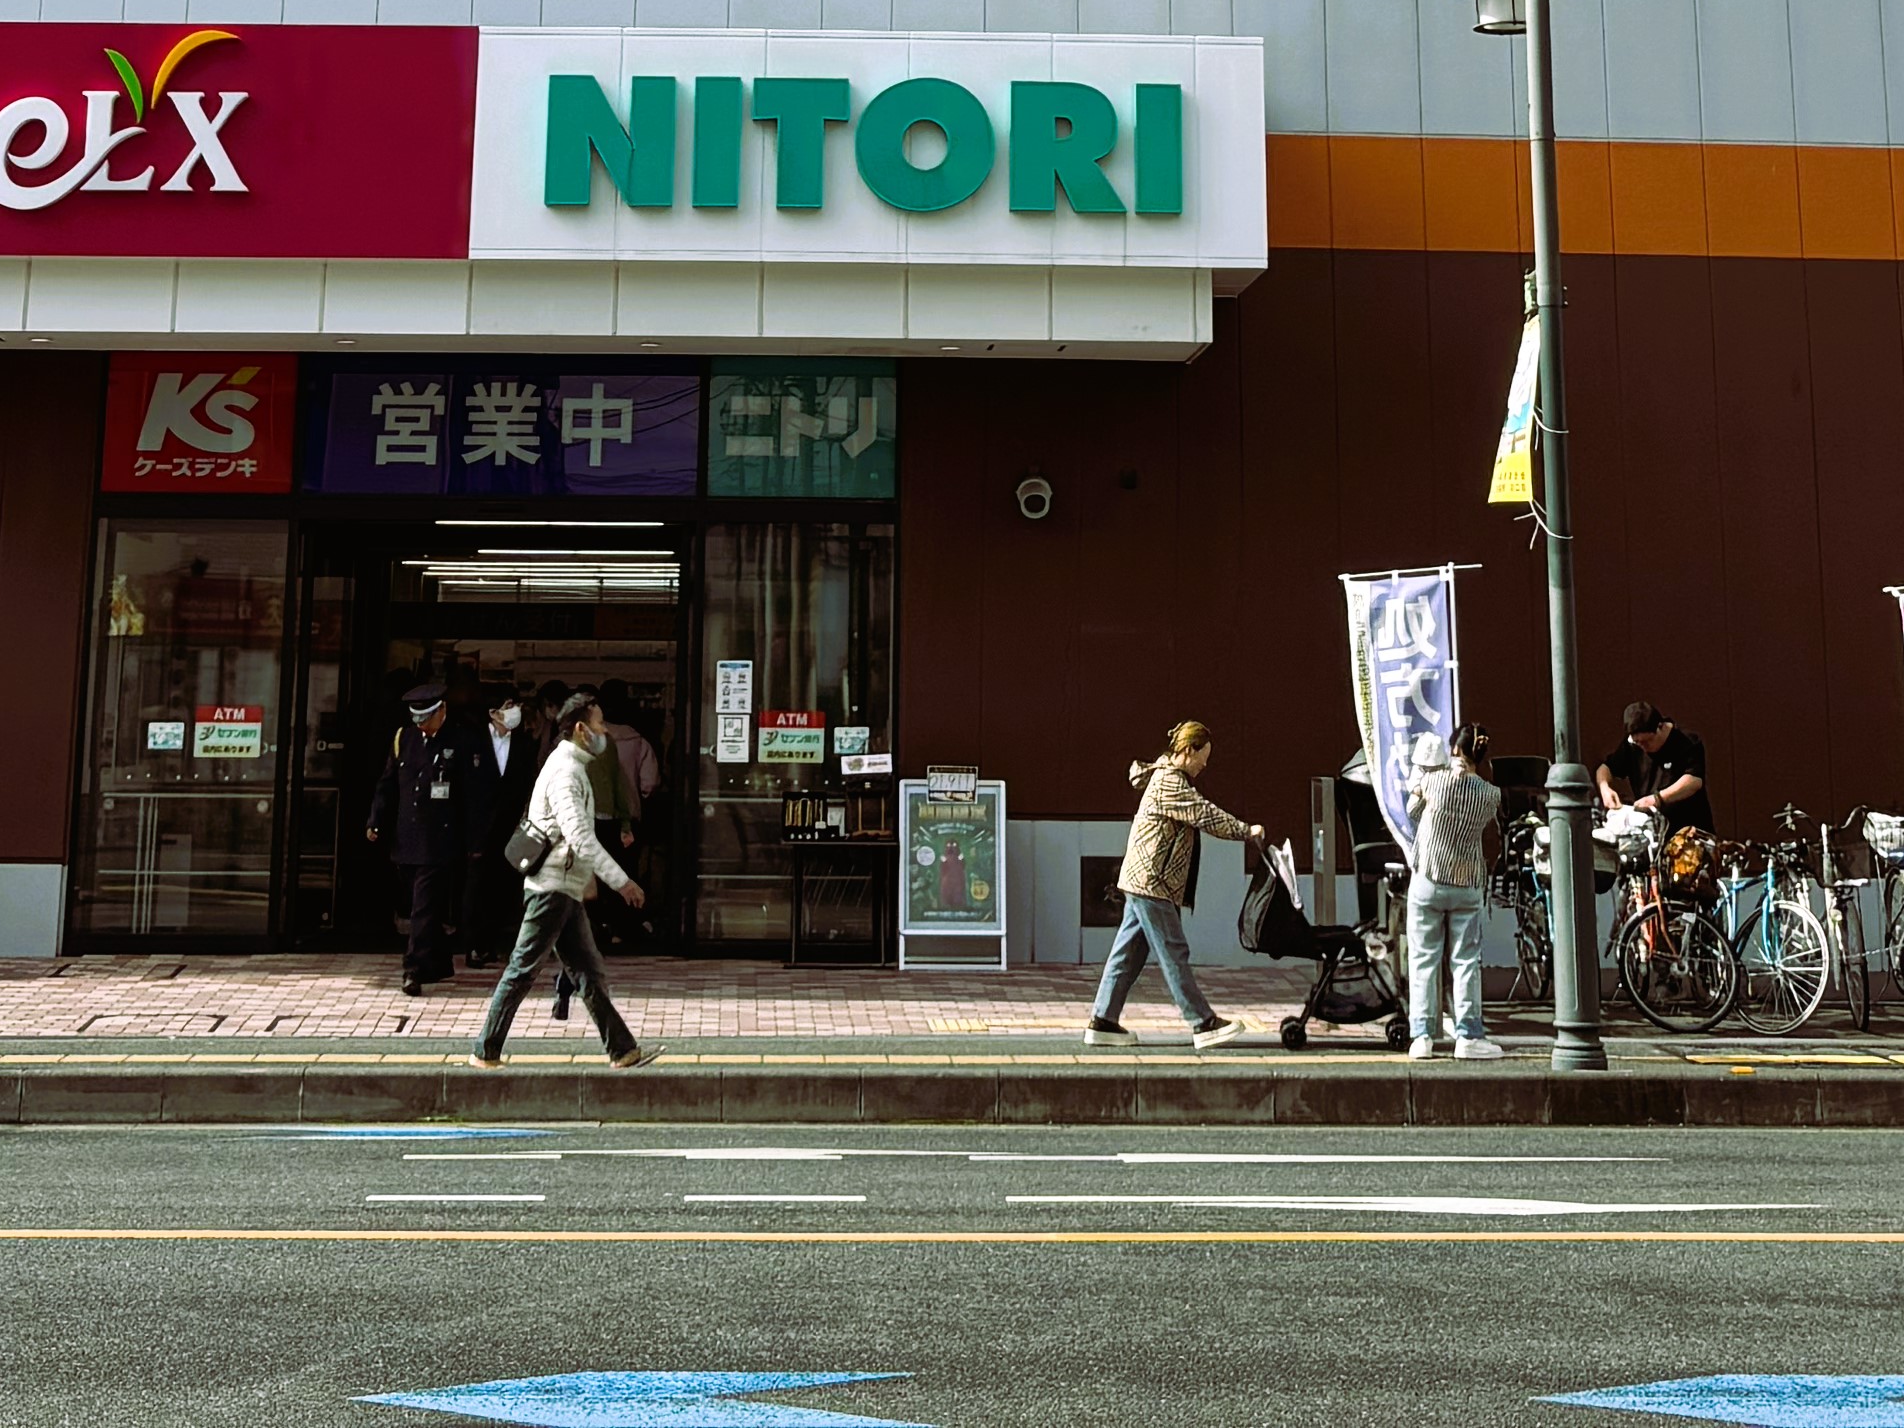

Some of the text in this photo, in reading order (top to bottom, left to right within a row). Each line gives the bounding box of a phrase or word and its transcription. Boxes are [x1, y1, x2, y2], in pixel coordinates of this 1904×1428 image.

[543, 73, 1185, 219] NITORI
[371, 381, 634, 467] 営業中
[724, 395, 878, 460] ニトリ
[133, 456, 259, 479] ケーズデンキ
[213, 707, 246, 721] ATM
[776, 713, 808, 726] ATM
